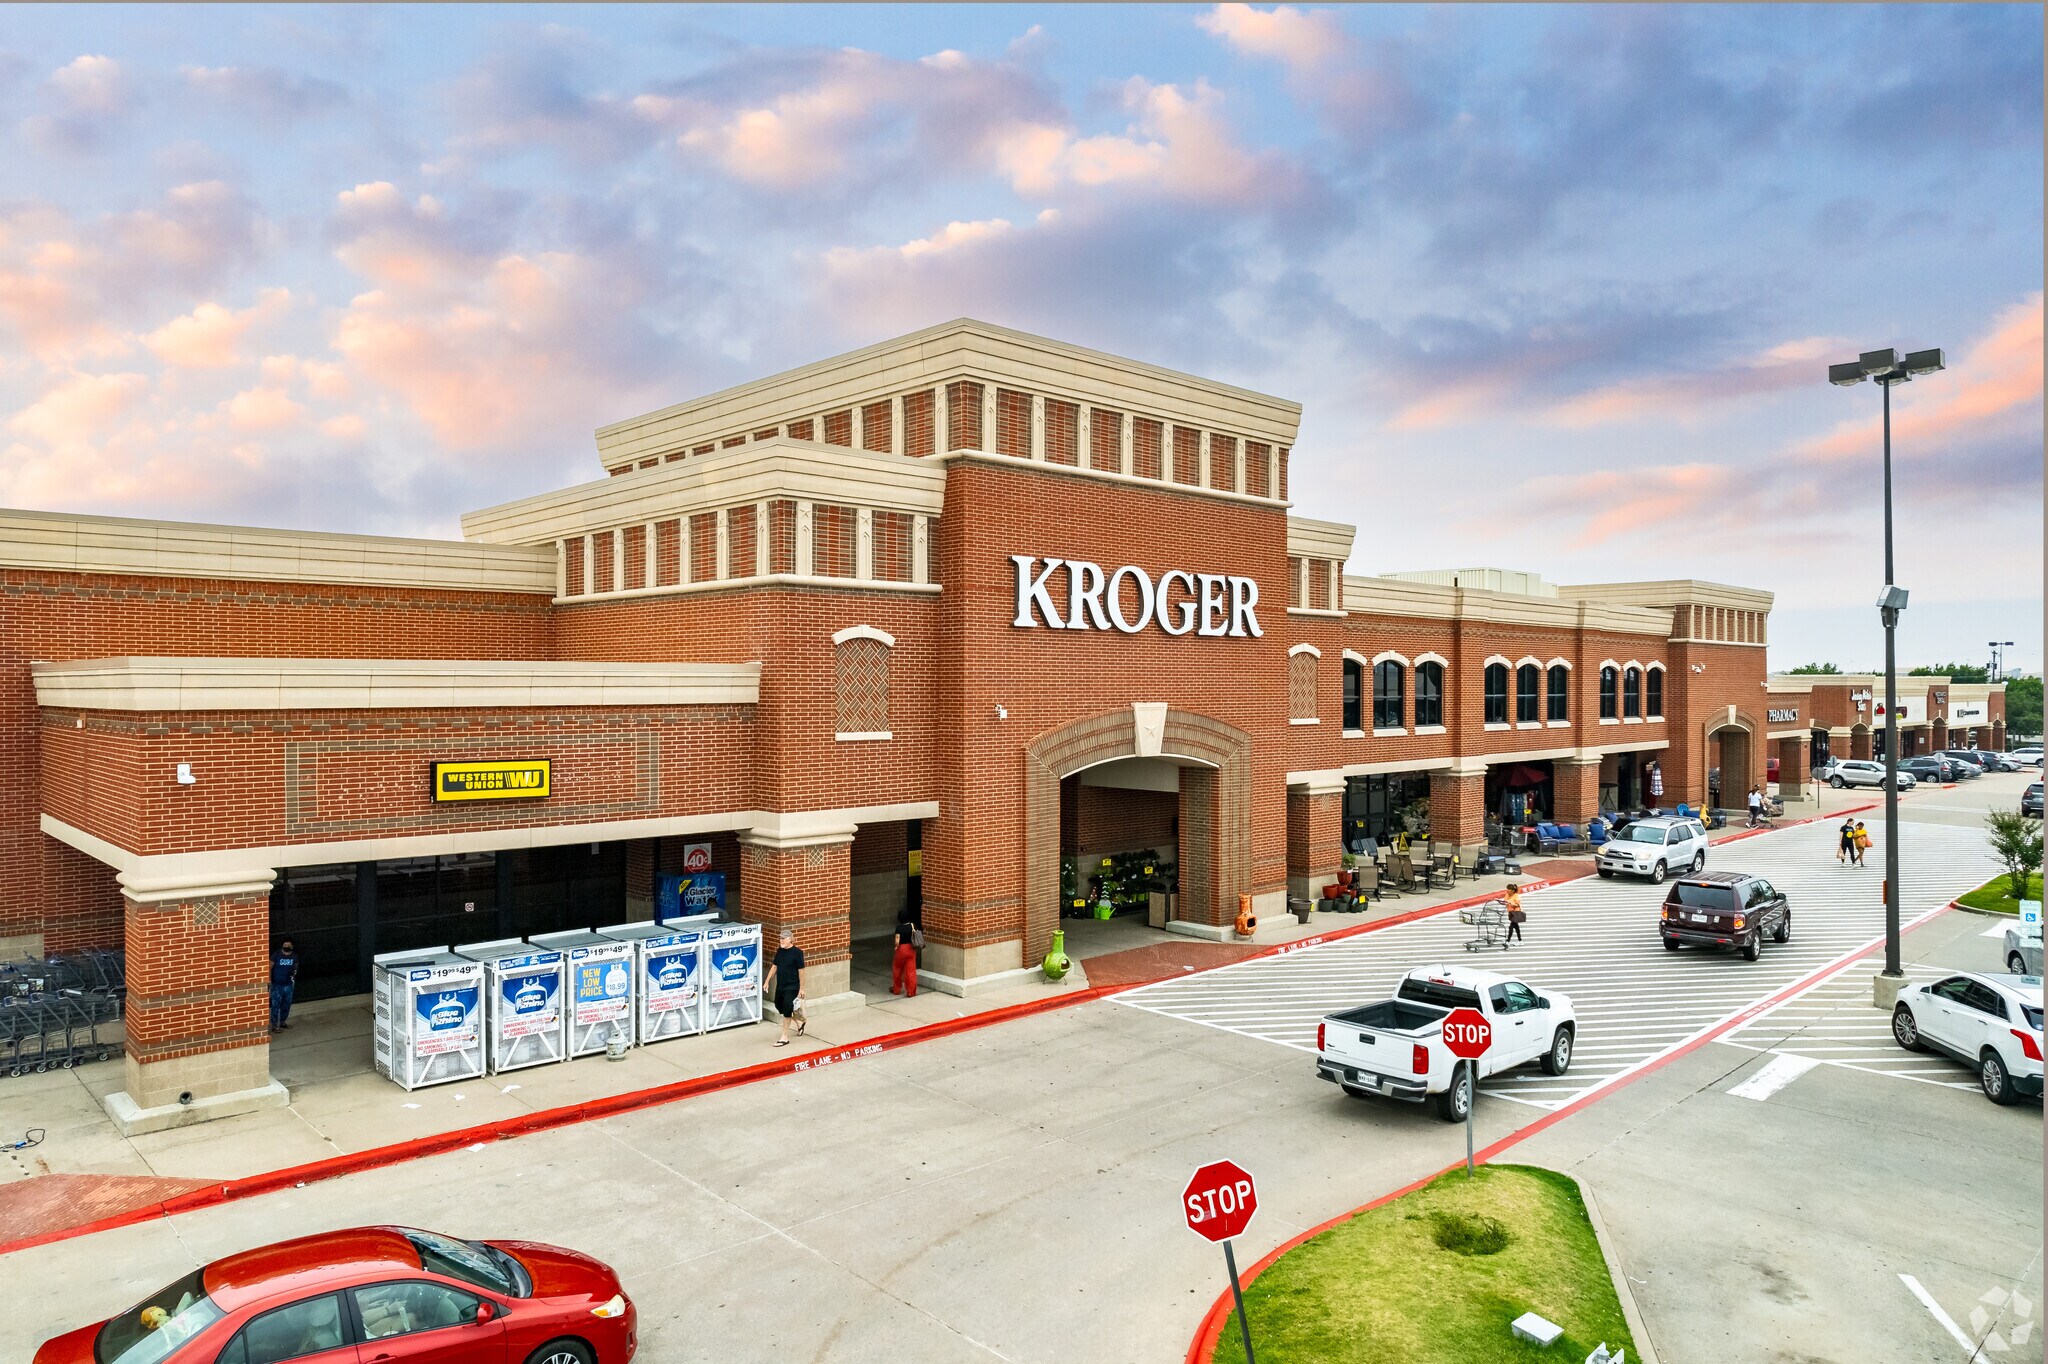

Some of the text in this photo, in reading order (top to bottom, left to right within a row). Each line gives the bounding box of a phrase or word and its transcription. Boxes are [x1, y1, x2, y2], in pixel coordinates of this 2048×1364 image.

[1010, 555, 1264, 637] KROGER
[1768, 708, 1799, 722] PHARMACY
[448, 773, 504, 783] WESTERN
[509, 771, 540, 788] WU
[465, 780, 504, 790] UNION
[688, 886, 716, 897] Glacier
[684, 894, 718, 907] Wat
[582, 967, 601, 978] NEW
[583, 977, 600, 988] LOW
[580, 986, 603, 998] PRICE
[1444, 1023, 1490, 1044] STOP
[794, 1060, 811, 1071] FIRE
[813, 1055, 833, 1067] LANE
[840, 1051, 851, 1061] NO
[854, 1043, 883, 1057] PARKING
[1187, 1180, 1252, 1224] STOP
